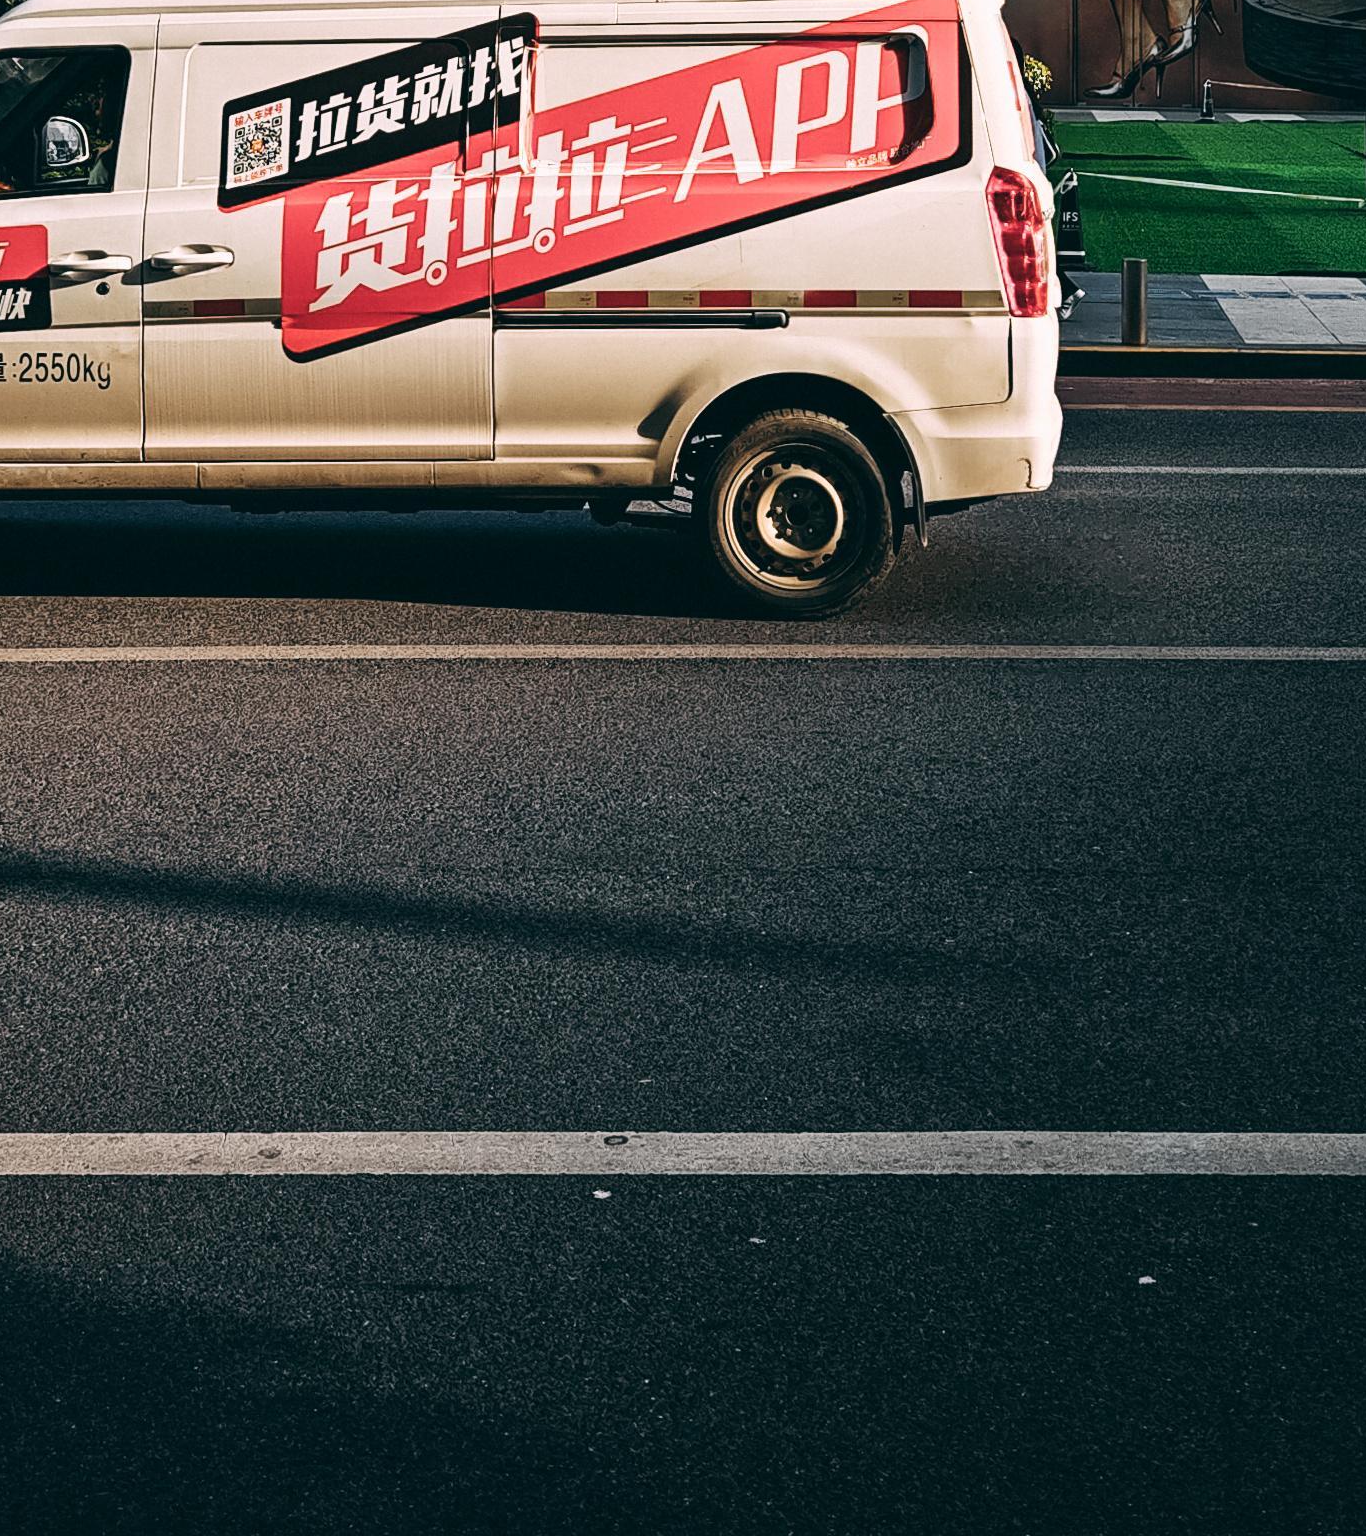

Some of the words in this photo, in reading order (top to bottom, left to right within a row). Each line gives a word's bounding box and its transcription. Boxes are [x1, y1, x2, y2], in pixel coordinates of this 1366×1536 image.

[294, 36, 525, 163] 拉货就找
[308, 115, 633, 313] 货拉拉
[1062, 211, 1079, 222] IFS
